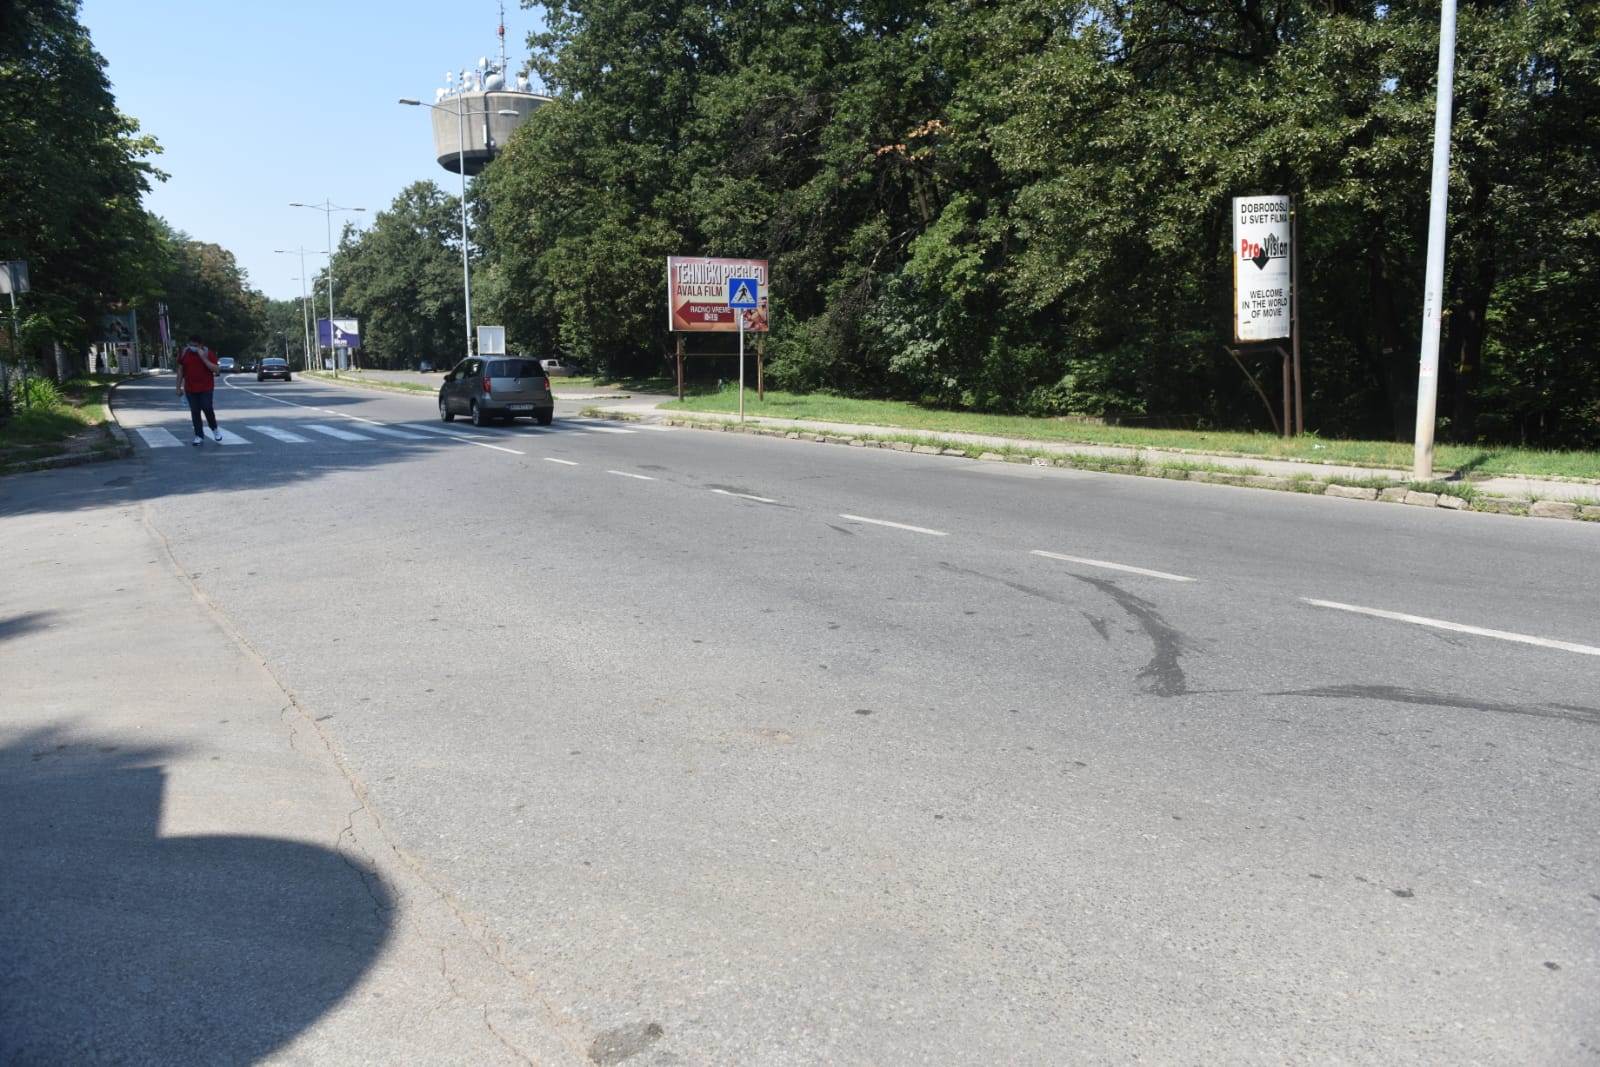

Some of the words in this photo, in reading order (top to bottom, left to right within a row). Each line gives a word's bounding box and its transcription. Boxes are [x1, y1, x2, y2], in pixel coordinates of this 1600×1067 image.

[1241, 215, 1247, 224] U
[1250, 214, 1269, 224] SVET
[675, 261, 722, 285] TEHNIČKI
[677, 285, 703, 297] AVALA
[704, 286, 723, 297] FILM
[1250, 288, 1283, 298] WELCOME
[1242, 301, 1250, 310] IN
[1252, 299, 1266, 309] THE
[1268, 297, 1287, 307] WORLD
[1251, 309, 1261, 318] OF
[1263, 308, 1282, 317] MOVIE
